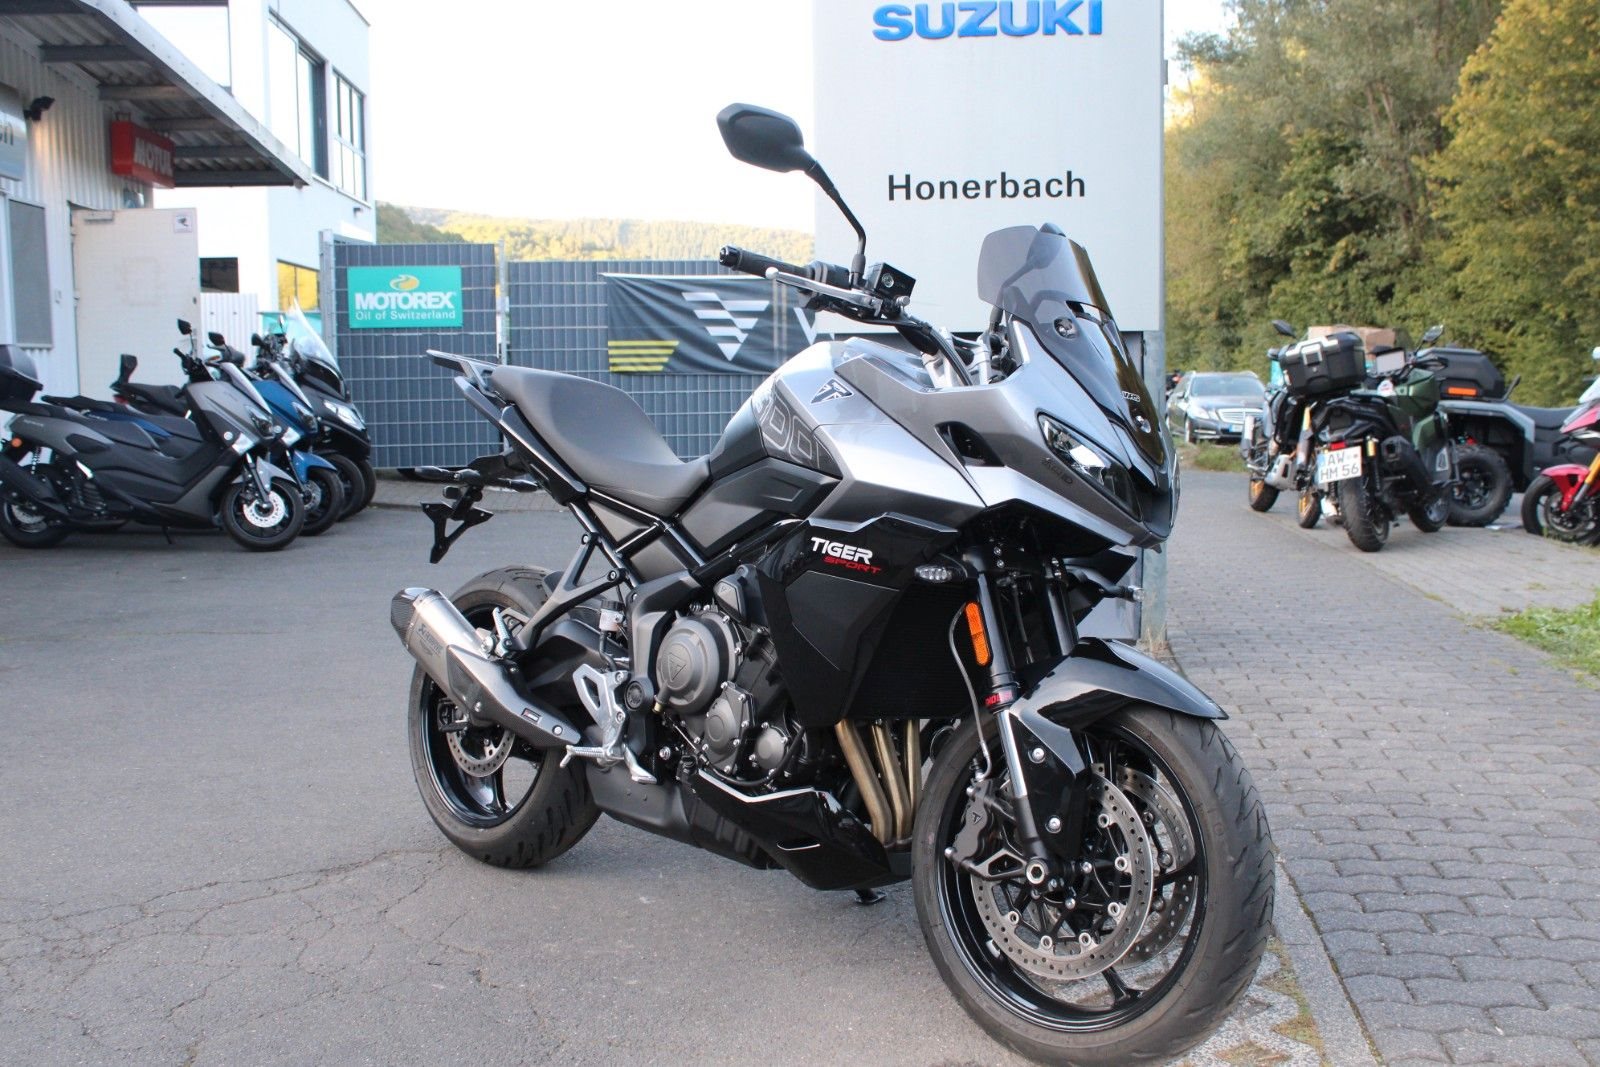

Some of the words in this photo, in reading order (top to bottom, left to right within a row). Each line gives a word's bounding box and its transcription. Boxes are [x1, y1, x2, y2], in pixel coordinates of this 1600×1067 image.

[872, 0, 1103, 41] SUZUKI
[888, 170, 1085, 201] Honerbach
[354, 291, 455, 311] MOTOREX
[355, 310, 371, 321] Oil
[375, 310, 387, 320] of
[390, 310, 456, 320] Switzerland
[1328, 450, 1345, 466] AW
[1320, 467, 1338, 481] HM
[1342, 463, 1360, 477] 56
[810, 536, 873, 565] TIGER
[822, 555, 885, 574] SPORT
